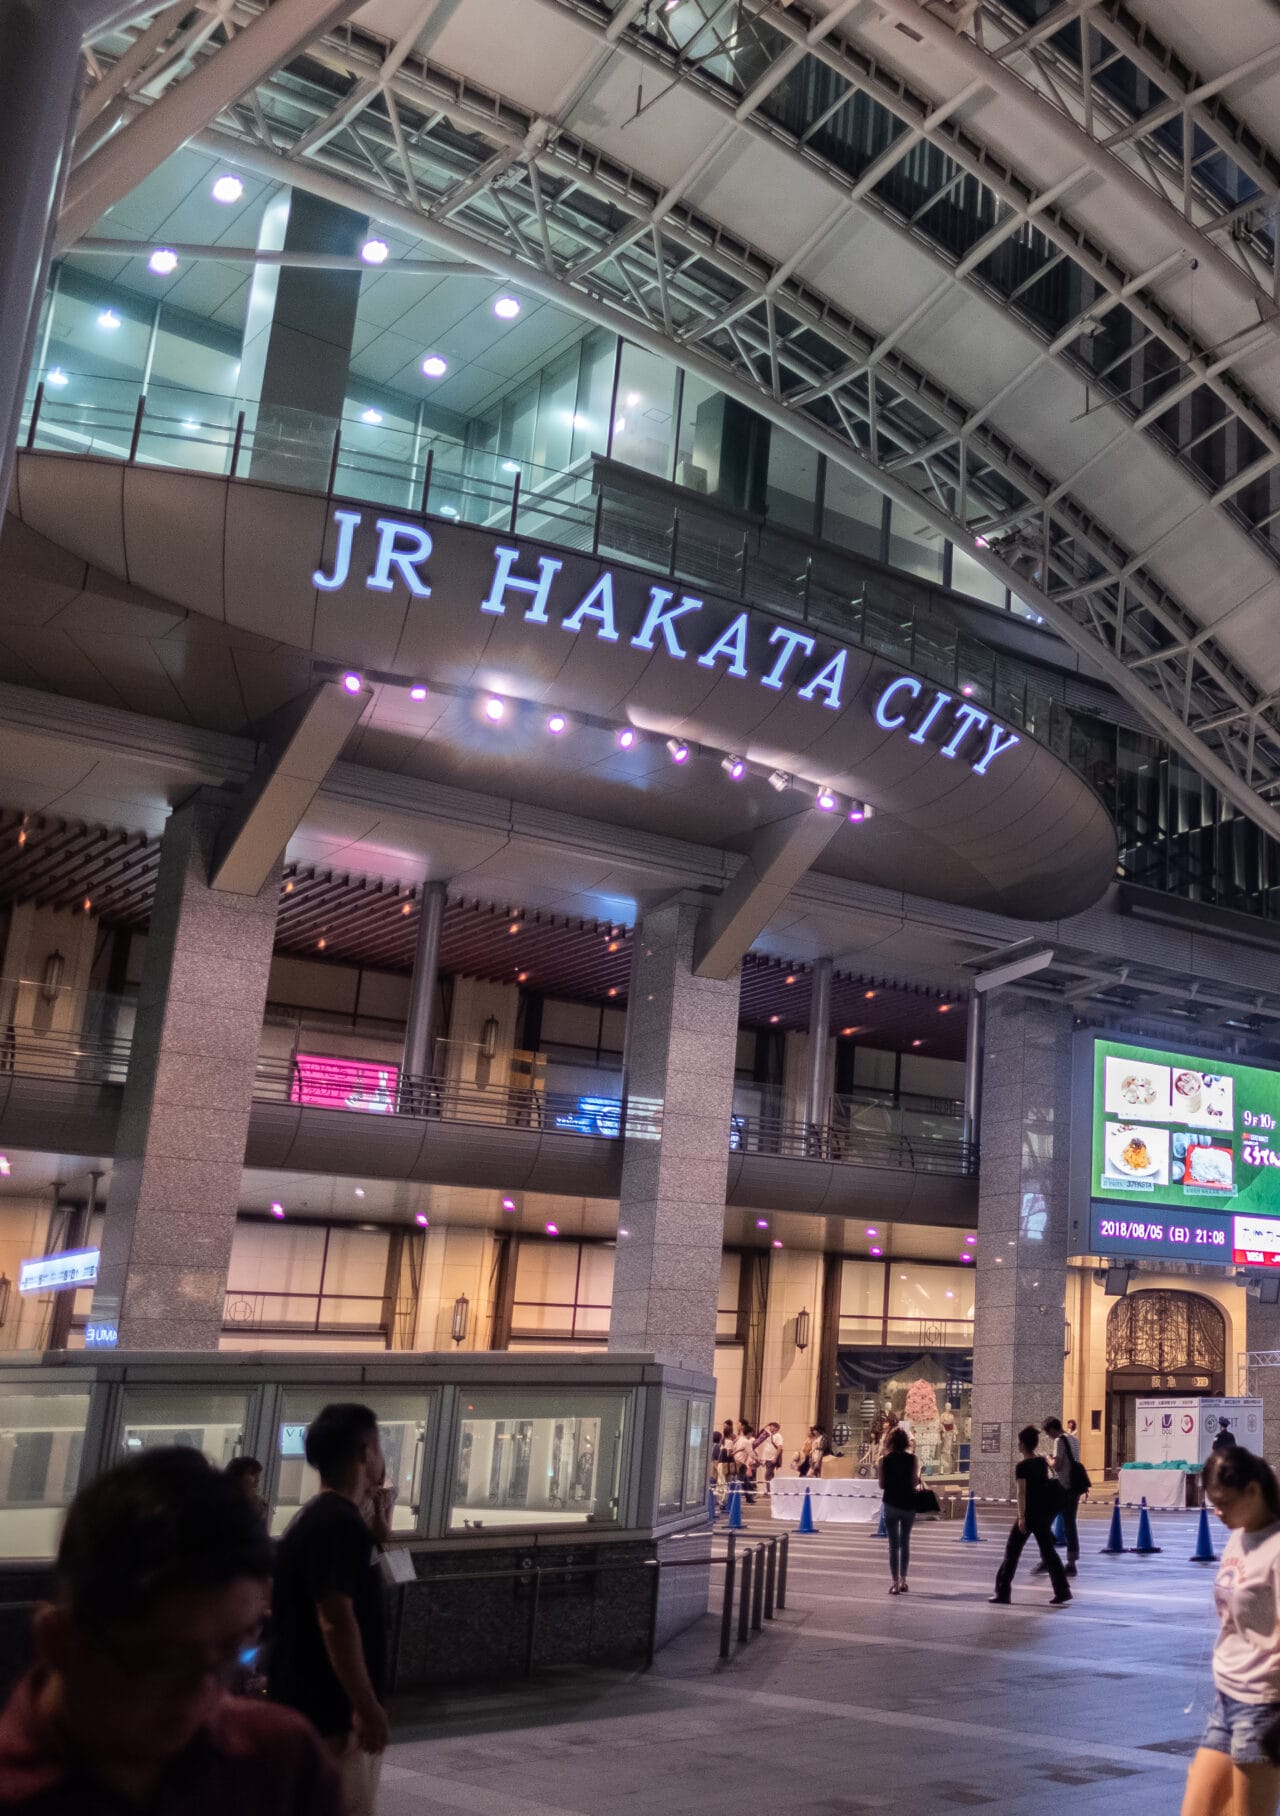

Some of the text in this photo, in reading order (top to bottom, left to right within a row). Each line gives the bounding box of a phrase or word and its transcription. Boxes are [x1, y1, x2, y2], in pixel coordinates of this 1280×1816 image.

[312, 510, 1020, 776] JR HAKATA CITY
[1244, 1110, 1276, 1129] 9F 10F
[1101, 1220, 1163, 1240] 2018/08/05
[1195, 1229, 1225, 1245] 21:08
